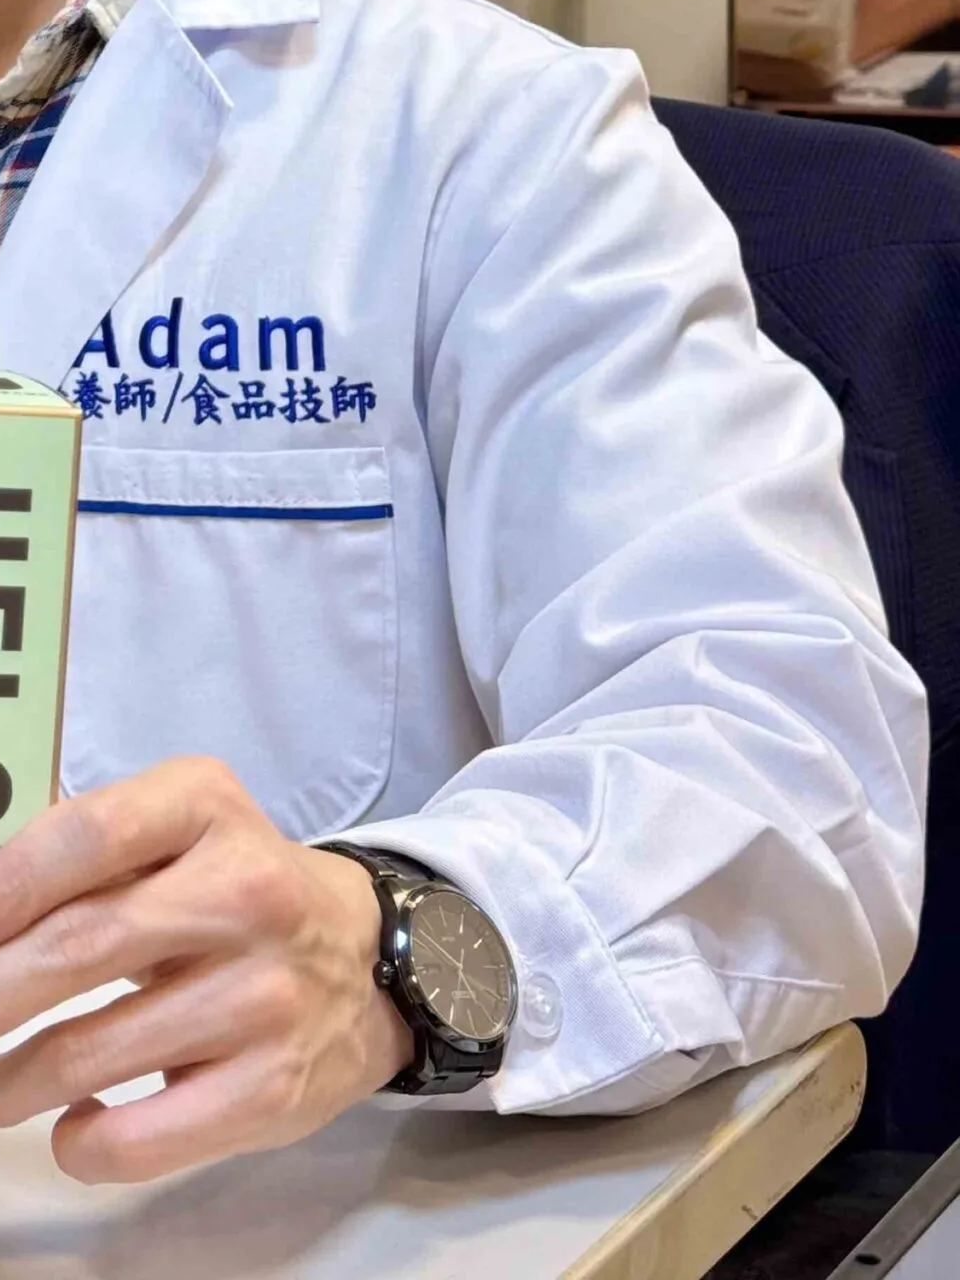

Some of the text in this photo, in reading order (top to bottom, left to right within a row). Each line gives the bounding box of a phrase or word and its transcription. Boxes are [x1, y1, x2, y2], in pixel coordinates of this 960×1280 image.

[72, 297, 326, 371] Adam
[58, 370, 378, 424] 養師/食品技師
